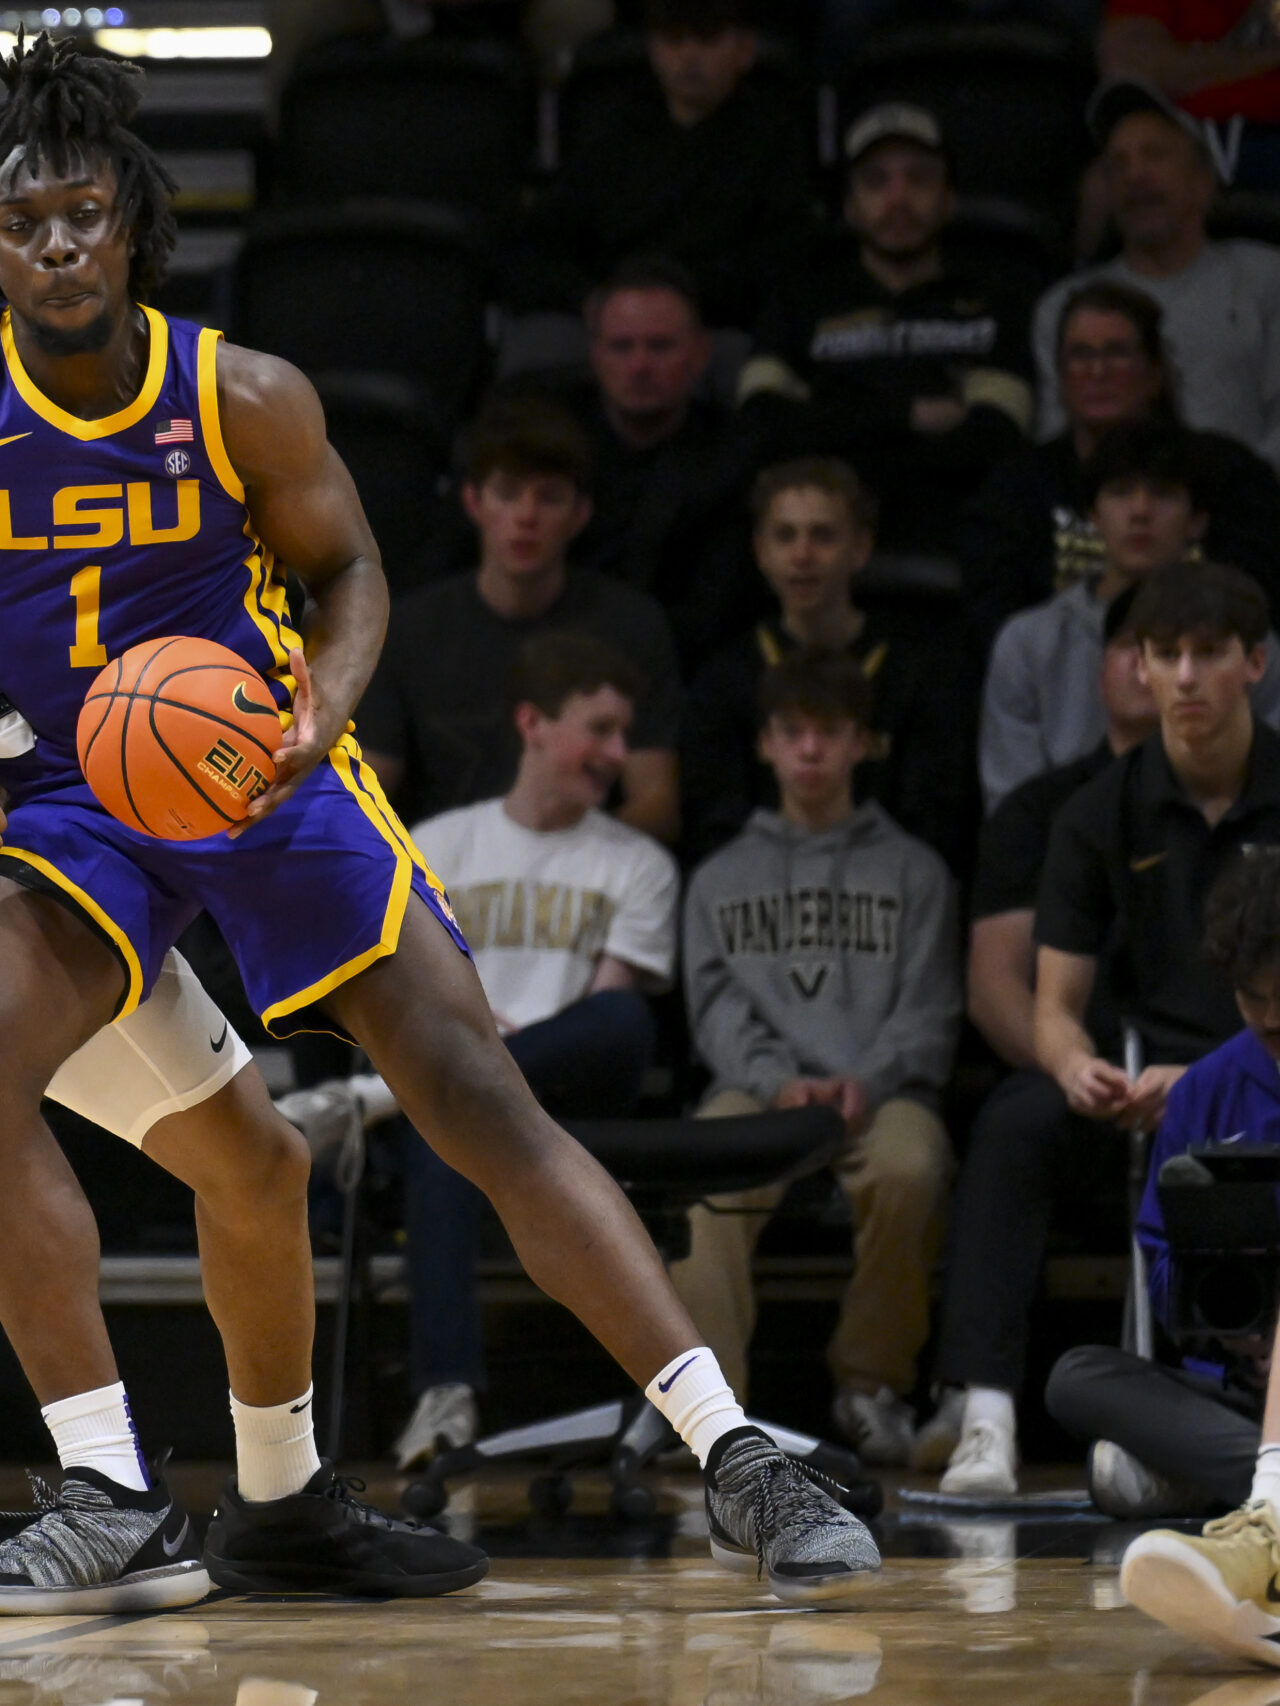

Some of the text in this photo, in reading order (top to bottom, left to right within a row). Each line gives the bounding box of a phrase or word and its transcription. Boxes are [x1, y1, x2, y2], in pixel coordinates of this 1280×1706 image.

[167, 451, 188, 475] SEC
[69, 565, 108, 668] 1
[715, 885, 901, 962] VANDERBILT
[787, 962, 835, 1001] V
